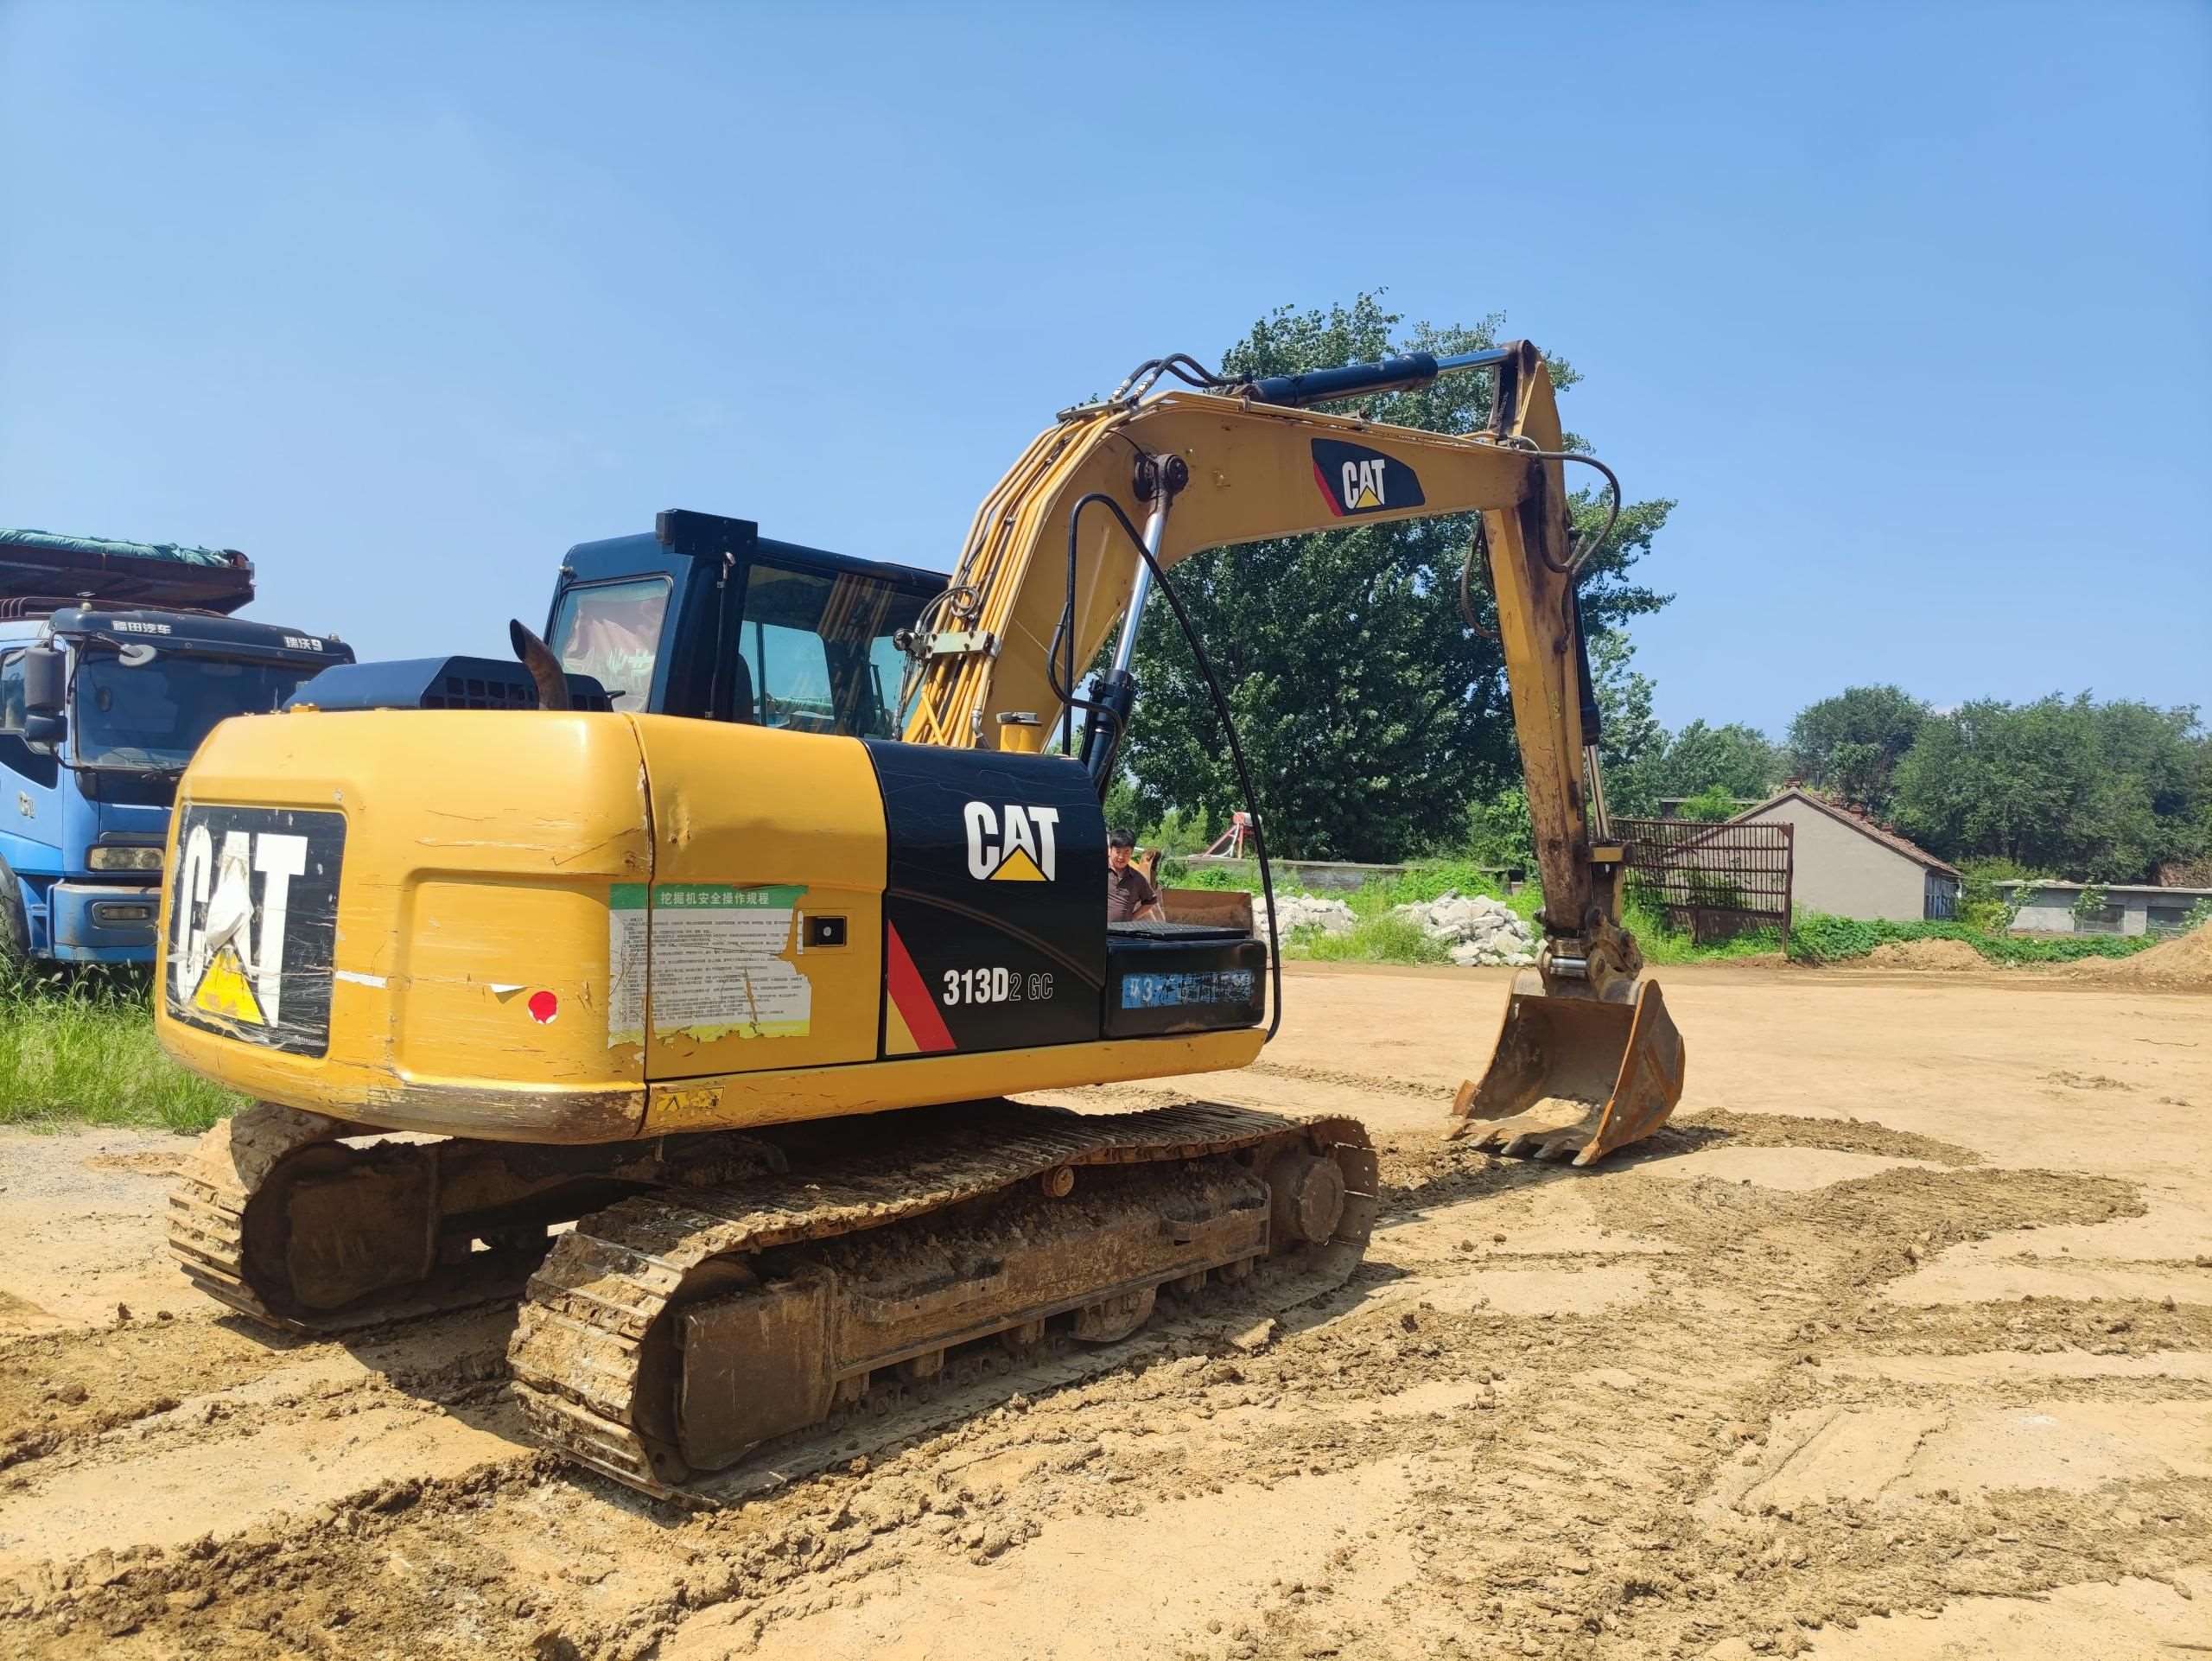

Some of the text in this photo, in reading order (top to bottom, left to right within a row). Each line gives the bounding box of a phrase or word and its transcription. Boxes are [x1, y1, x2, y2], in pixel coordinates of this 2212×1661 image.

[1342, 459, 1385, 509] CAT
[963, 801, 1059, 881] CAT
[660, 891, 770, 905] 挖掘机安全操作规程
[175, 824, 308, 1028] CAT
[1027, 972, 1053, 1001] GC
